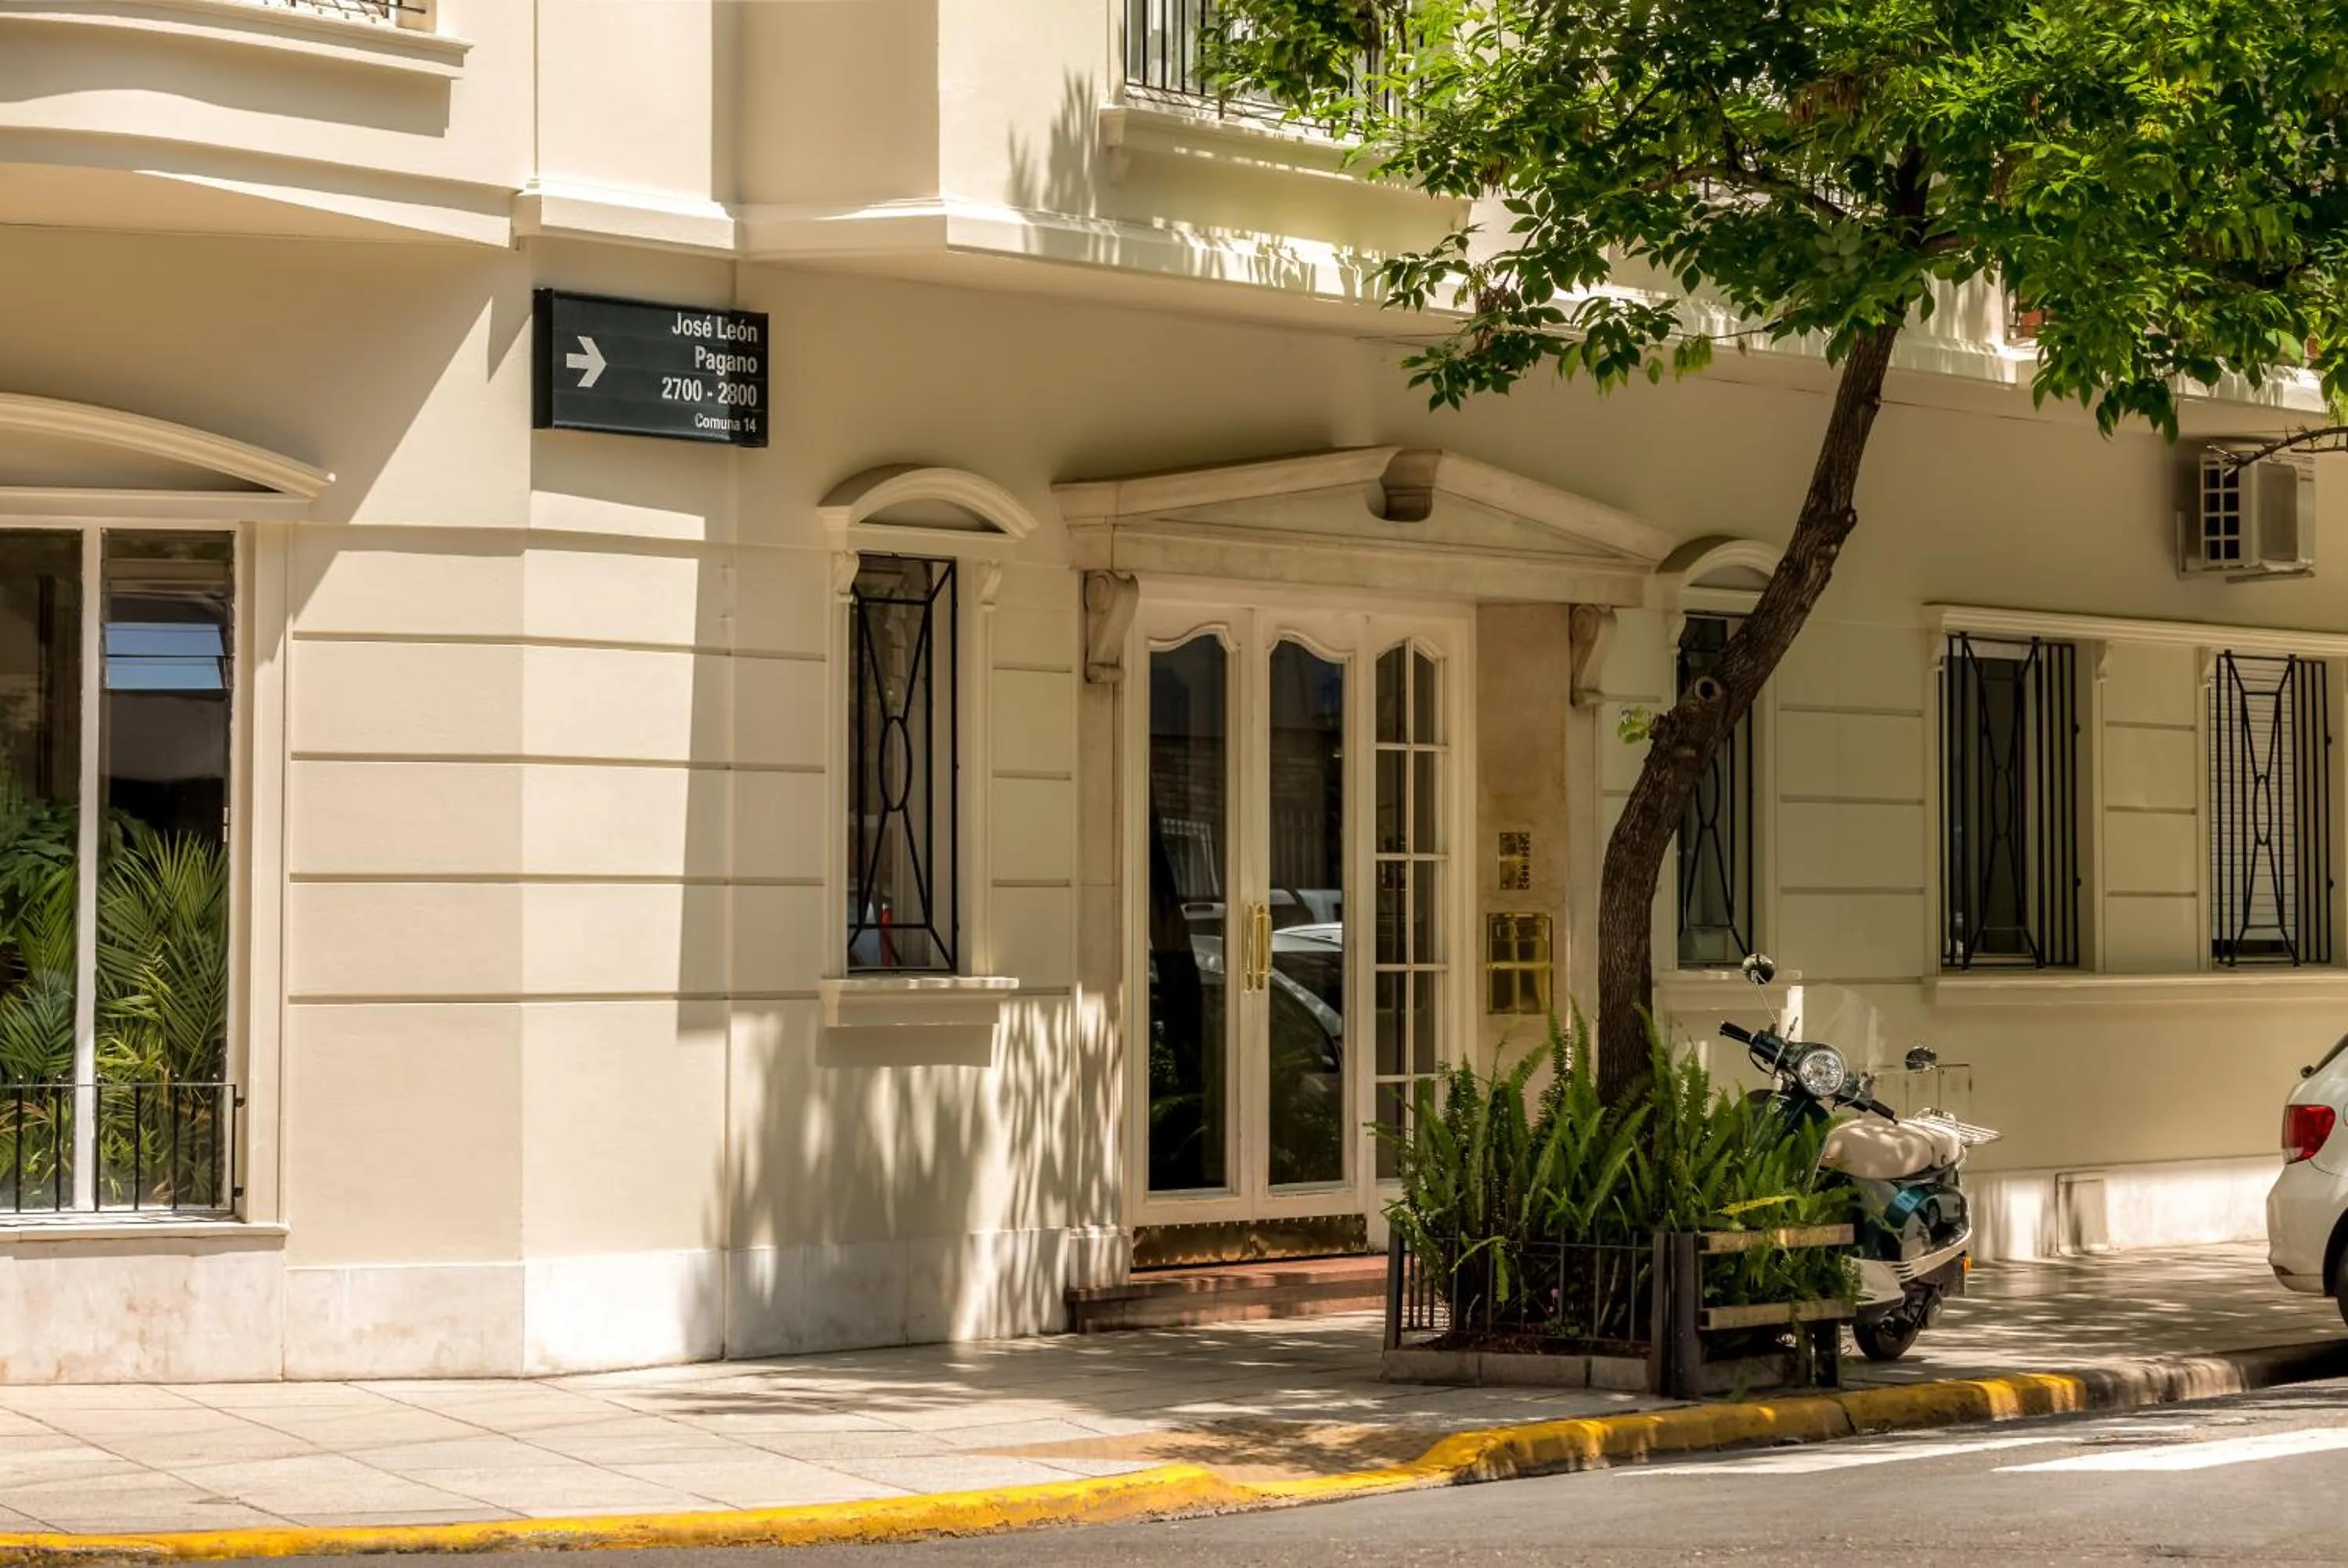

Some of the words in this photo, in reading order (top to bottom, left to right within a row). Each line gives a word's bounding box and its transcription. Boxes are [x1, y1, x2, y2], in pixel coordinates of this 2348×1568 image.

[672, 313, 712, 339] José
[717, 315, 758, 343] León
[694, 346, 758, 376] Pagano
[661, 376, 702, 402] 2700
[718, 382, 757, 407] 2800
[694, 413, 741, 430] Comuna
[744, 418, 757, 433] 14
